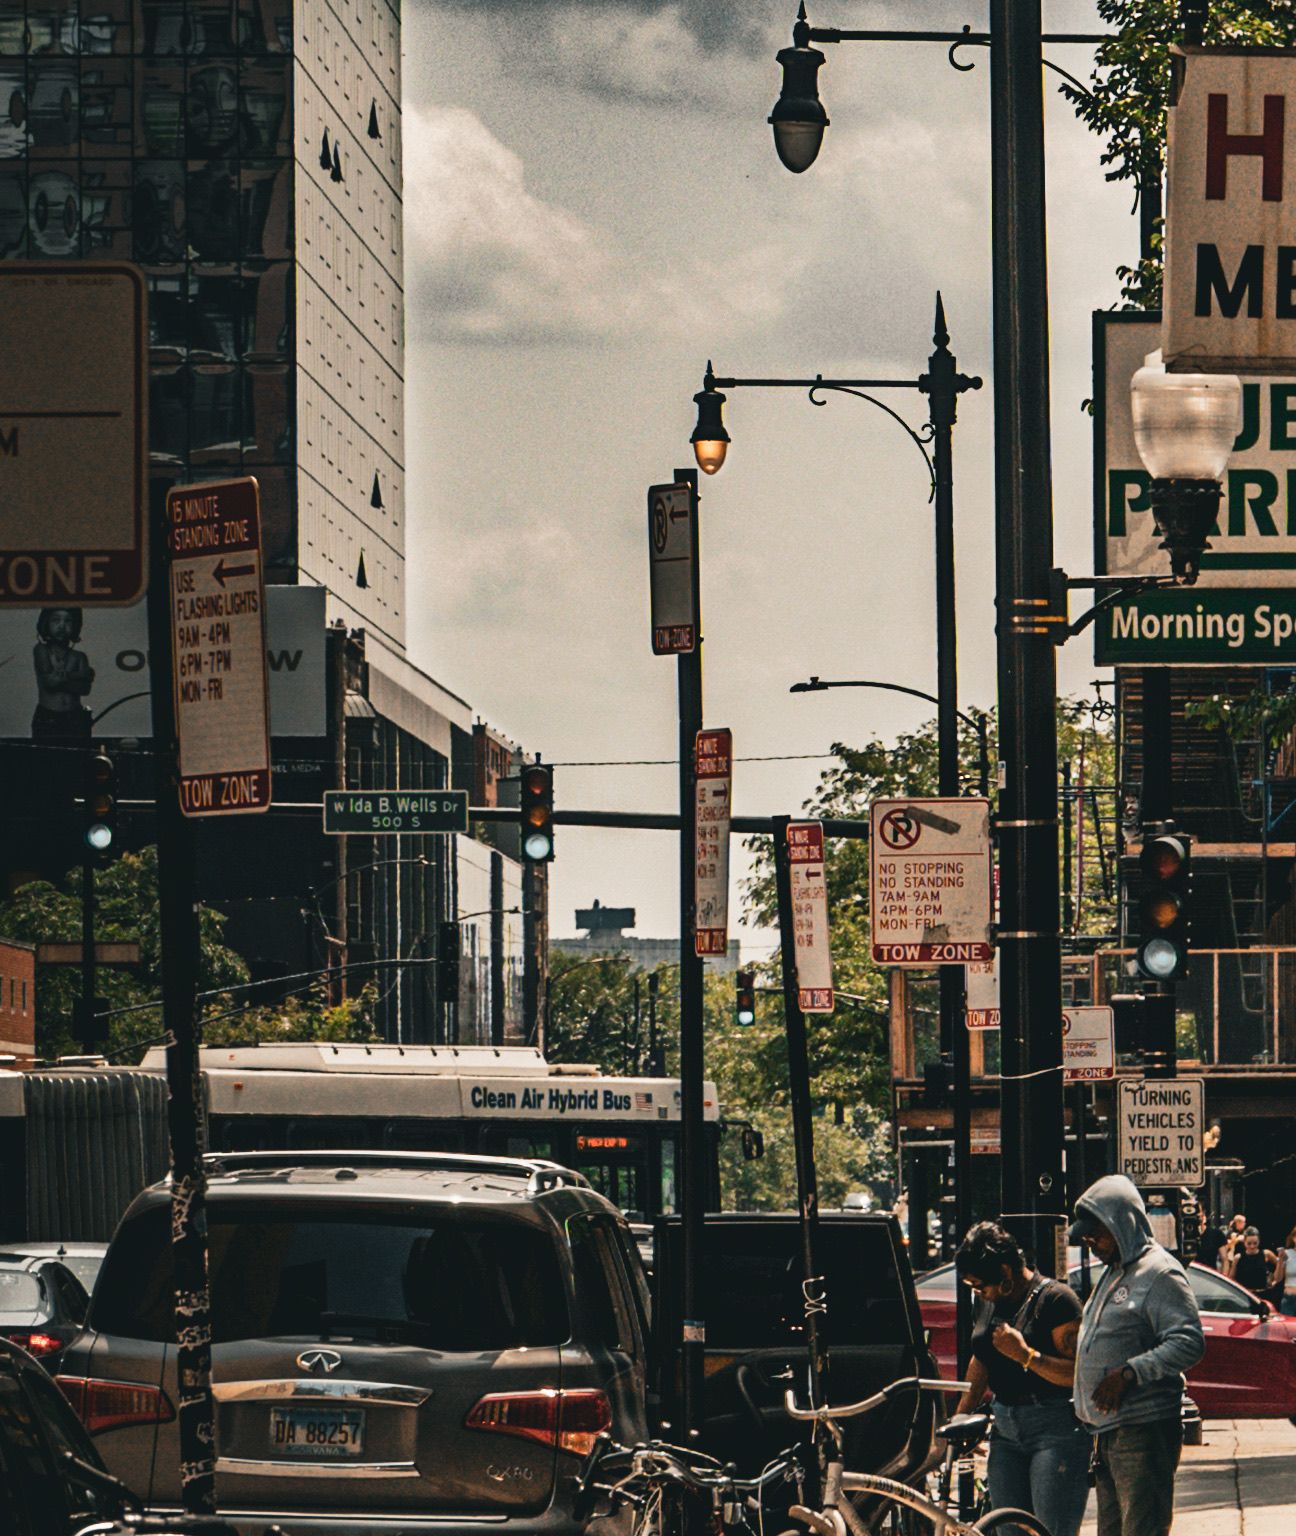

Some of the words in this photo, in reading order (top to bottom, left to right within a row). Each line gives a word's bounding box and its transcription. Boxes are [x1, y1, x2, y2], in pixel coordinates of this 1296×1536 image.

[172, 500, 182, 523] 15
[185, 496, 219, 521] MINUTE
[175, 523, 219, 550] STANDING
[224, 520, 249, 544] ZONE
[176, 570, 195, 593] USE
[177, 594, 223, 621] FLASHING
[224, 591, 258, 615] LIGHTS
[1111, 608, 1245, 647] Morning
[182, 779, 213, 808] TOW
[221, 775, 260, 806] ZONE
[349, 798, 373, 813] Ida
[379, 797, 392, 813] B.
[396, 797, 437, 813] Wells
[443, 801, 459, 813] Dr
[372, 816, 402, 828] 500
[411, 816, 421, 828] S
[879, 864, 896, 875] NO
[904, 862, 964, 875] STOPPING
[879, 877, 896, 888] NO
[904, 876, 964, 888] STANDING
[880, 890, 940, 902] 7AM-9AM
[880, 904, 942, 916] 4PM-6PM
[879, 918, 938, 930] MON-FRI
[880, 945, 920, 961] TOW
[931, 944, 983, 960] ZONE
[968, 1011, 985, 1026] TOW
[989, 1010, 1000, 1025] ZO
[1078, 1067, 1109, 1079] ZONE
[471, 1086, 517, 1109] Clean
[521, 1087, 544, 1110] Air
[548, 1089, 598, 1114] Hybrid
[602, 1090, 632, 1111] Bus
[1129, 1090, 1192, 1106] TURNING
[1127, 1113, 1195, 1129] VEHICLES
[1129, 1135, 1169, 1151] YIELD
[1177, 1135, 1194, 1151] TO
[1124, 1157, 1199, 1174] PEDESTRANS
[274, 1420, 296, 1444] DA
[305, 1420, 361, 1445] 88257
